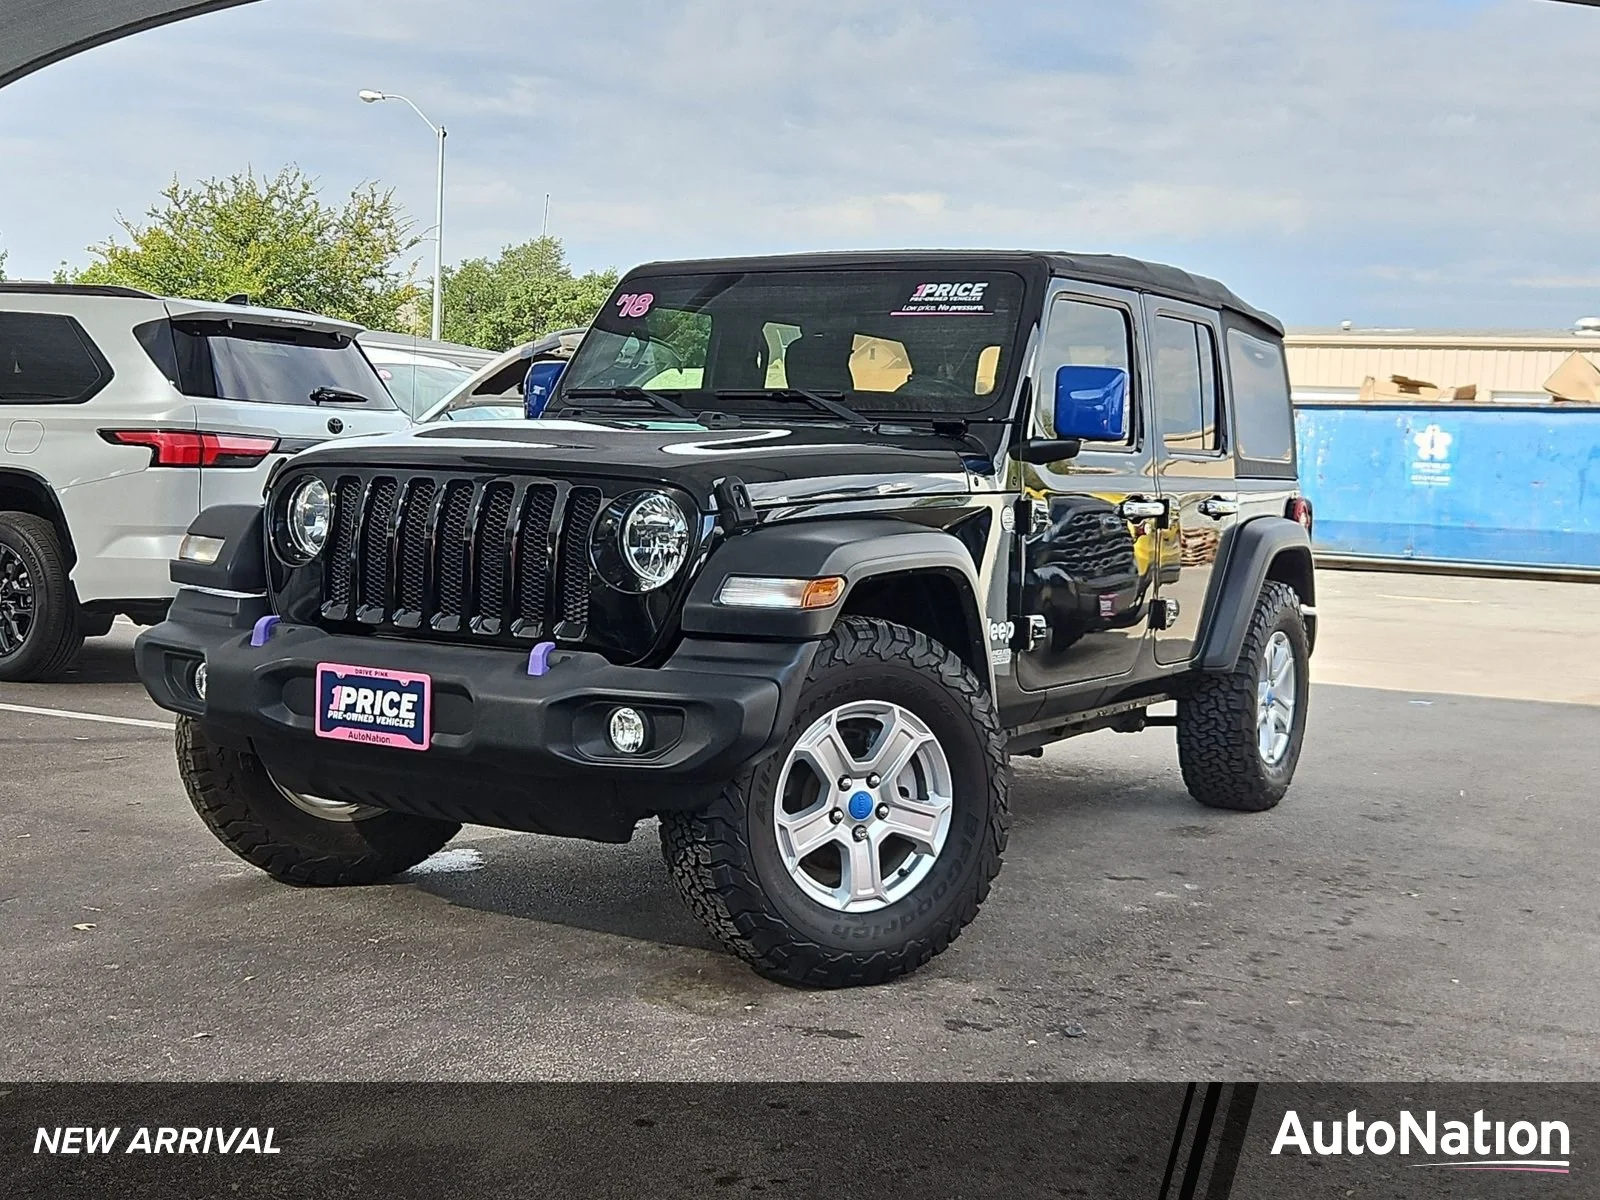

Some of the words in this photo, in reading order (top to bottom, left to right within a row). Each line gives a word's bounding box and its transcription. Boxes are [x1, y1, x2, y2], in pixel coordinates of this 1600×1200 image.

[354, 668, 373, 677] DRIVE
[328, 685, 418, 720] 1PRICE
[327, 710, 374, 724] PRE-OWNED
[376, 715, 415, 729] VEHICLES
[348, 731, 391, 744] AutoNation
